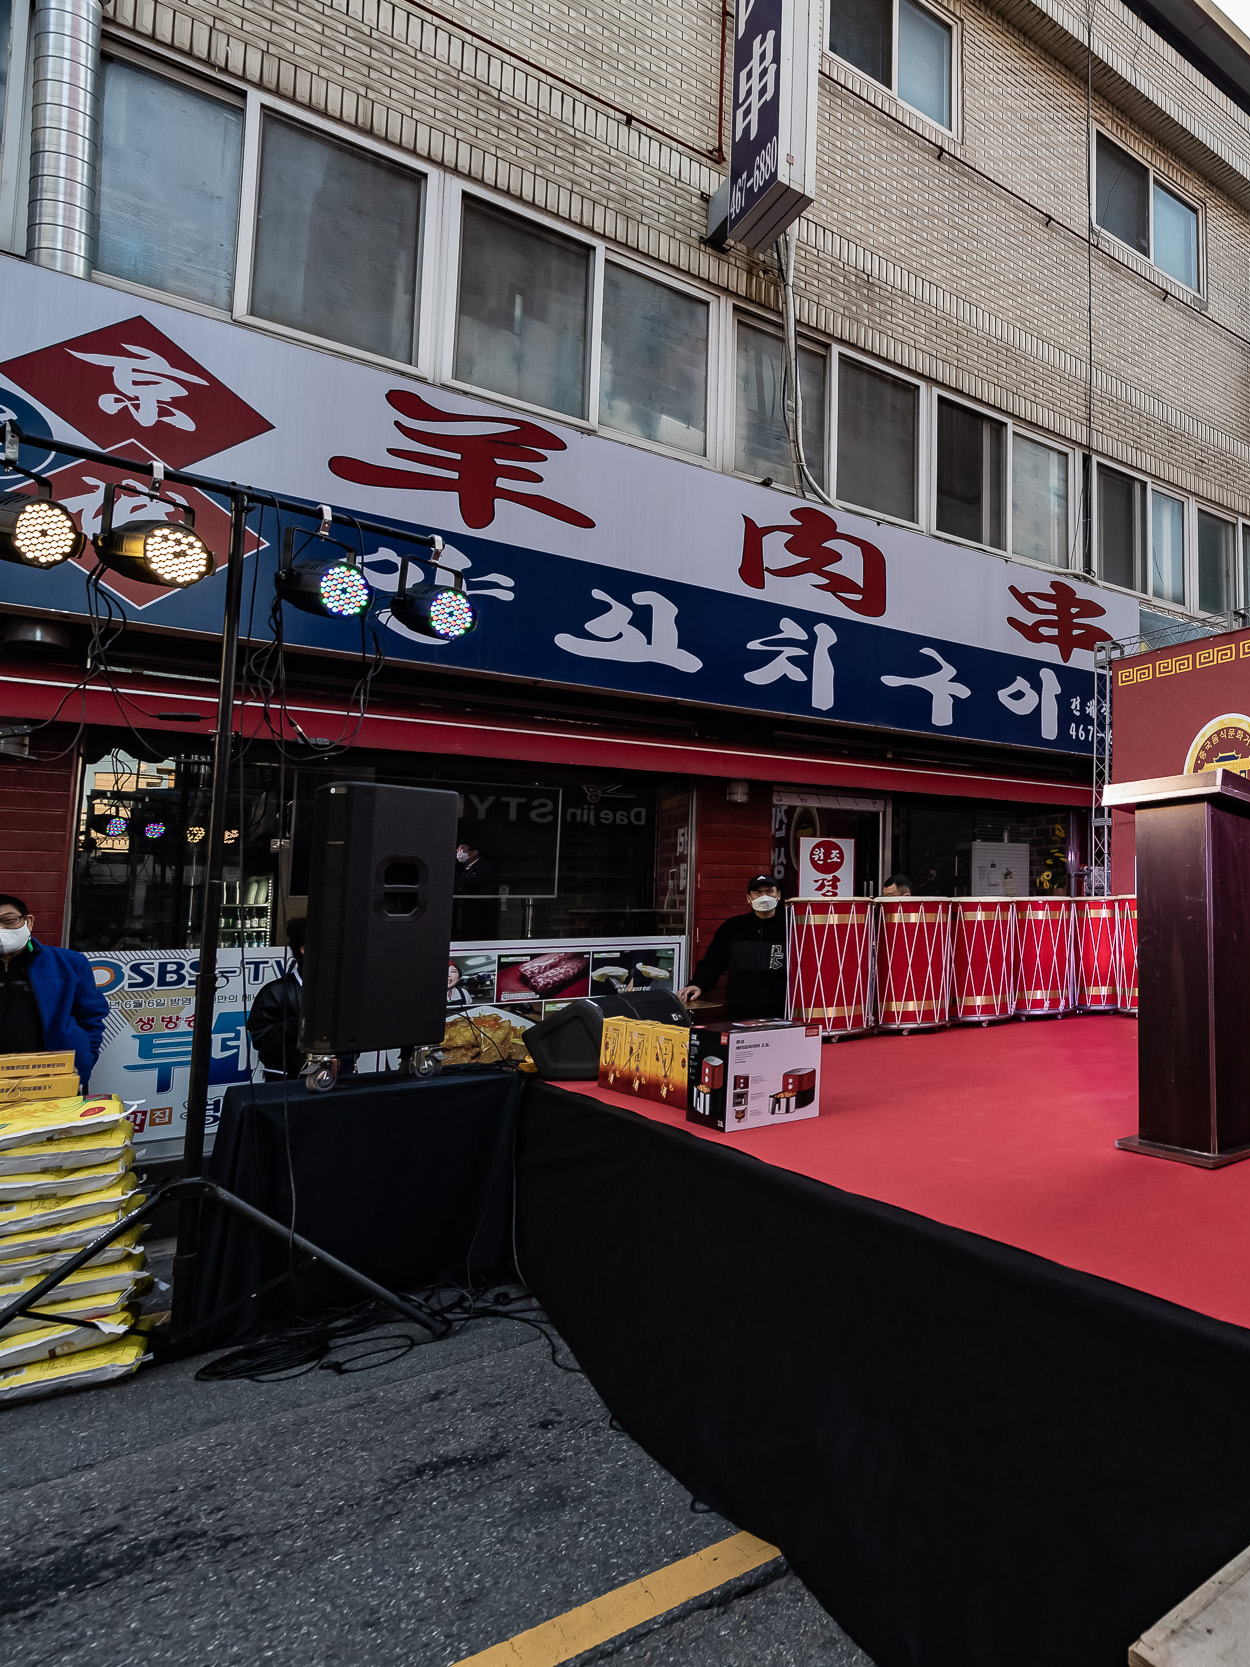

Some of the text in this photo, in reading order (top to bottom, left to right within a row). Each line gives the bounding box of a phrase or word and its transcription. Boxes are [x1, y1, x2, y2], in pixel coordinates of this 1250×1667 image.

[730, 136, 777, 220] 467-6880
[812, 847, 842, 865] 원조
[147, 998, 166, 1008] 6일
[170, 996, 192, 1006] 방영
